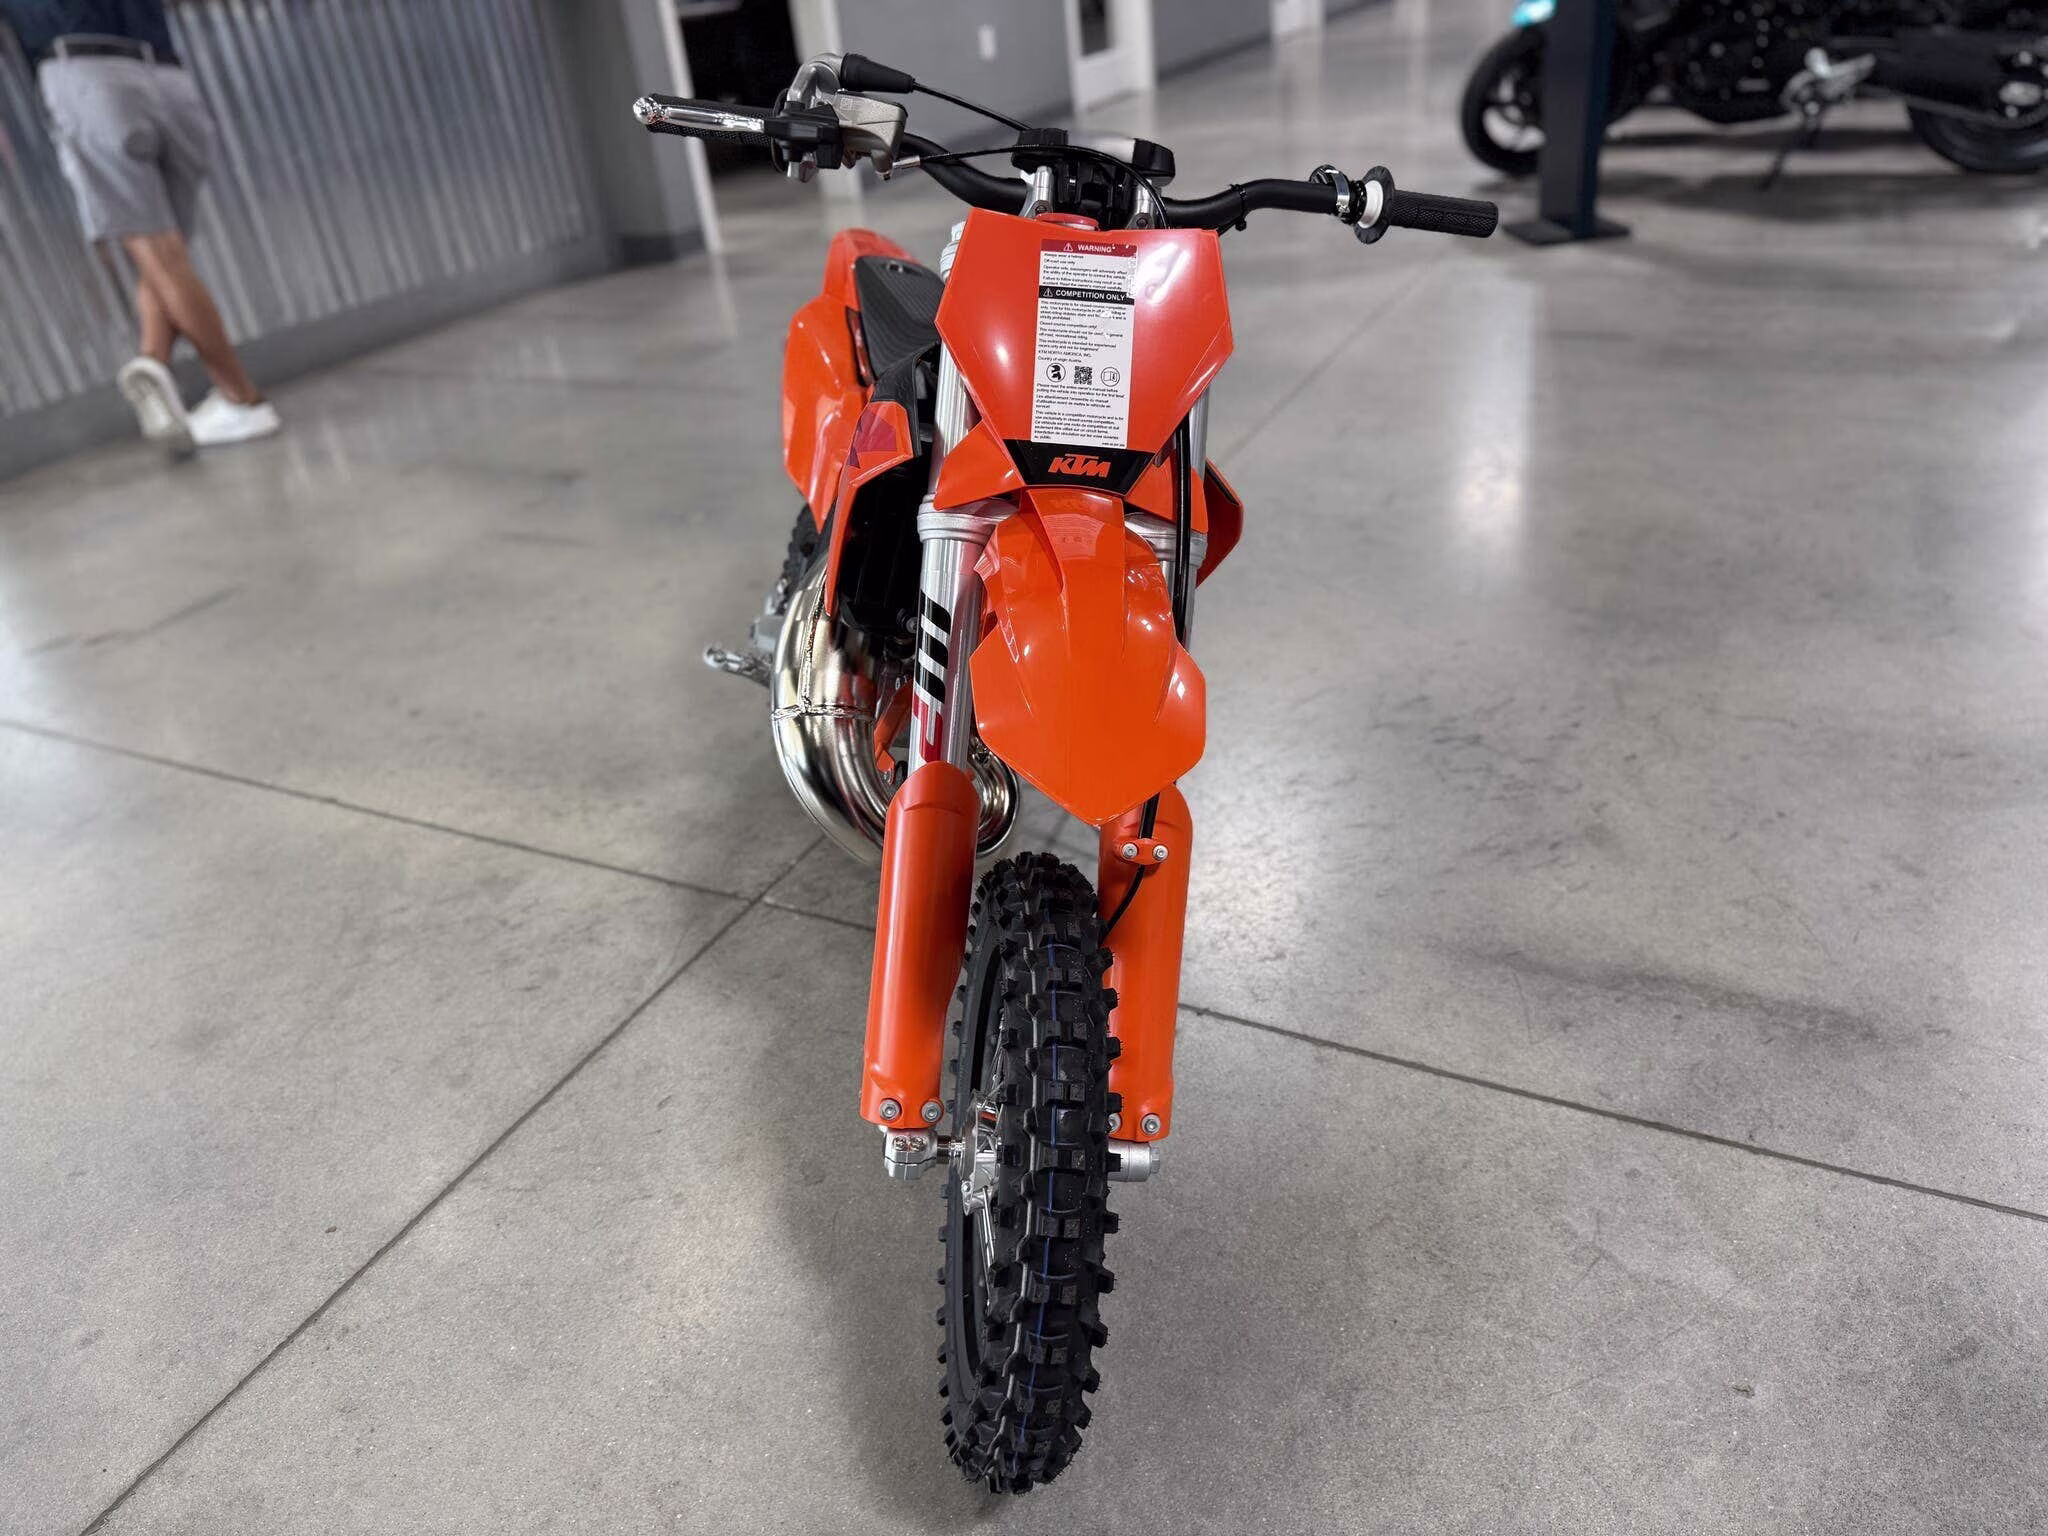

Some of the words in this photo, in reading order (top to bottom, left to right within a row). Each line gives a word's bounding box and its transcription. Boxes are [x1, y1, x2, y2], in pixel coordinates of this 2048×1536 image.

[1077, 244, 1112, 252] WARNING
[1055, 289, 1105, 299] COMPETITION
[1048, 453, 1111, 478] KTM
